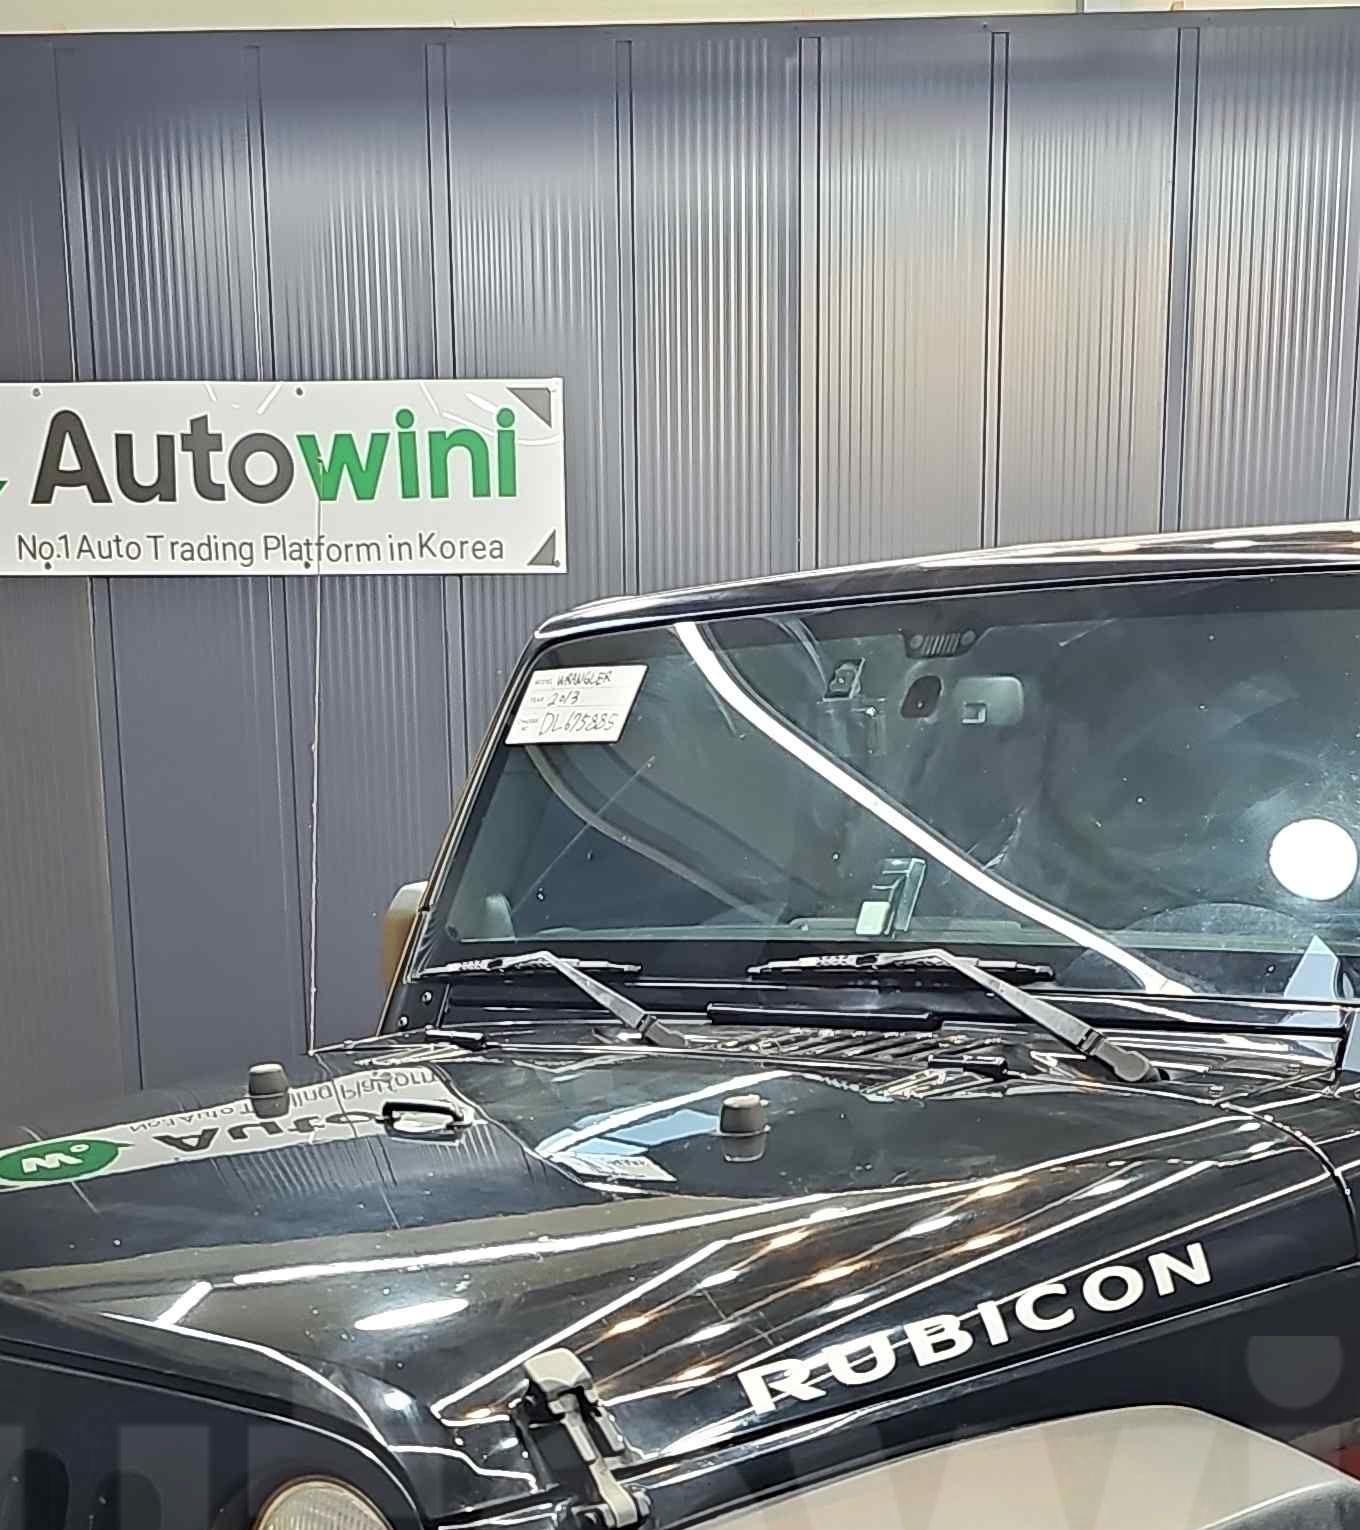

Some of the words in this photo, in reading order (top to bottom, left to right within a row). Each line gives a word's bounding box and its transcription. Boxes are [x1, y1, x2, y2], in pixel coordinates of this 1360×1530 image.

[29, 407, 520, 506] Autowini
[16, 534, 71, 562] No.1
[75, 535, 142, 561] Auto
[146, 534, 256, 568] Trading
[262, 534, 382, 563] Platform
[388, 533, 414, 562] in
[418, 532, 505, 561] Korea
[737, 1242, 1212, 1416] RUBICON
